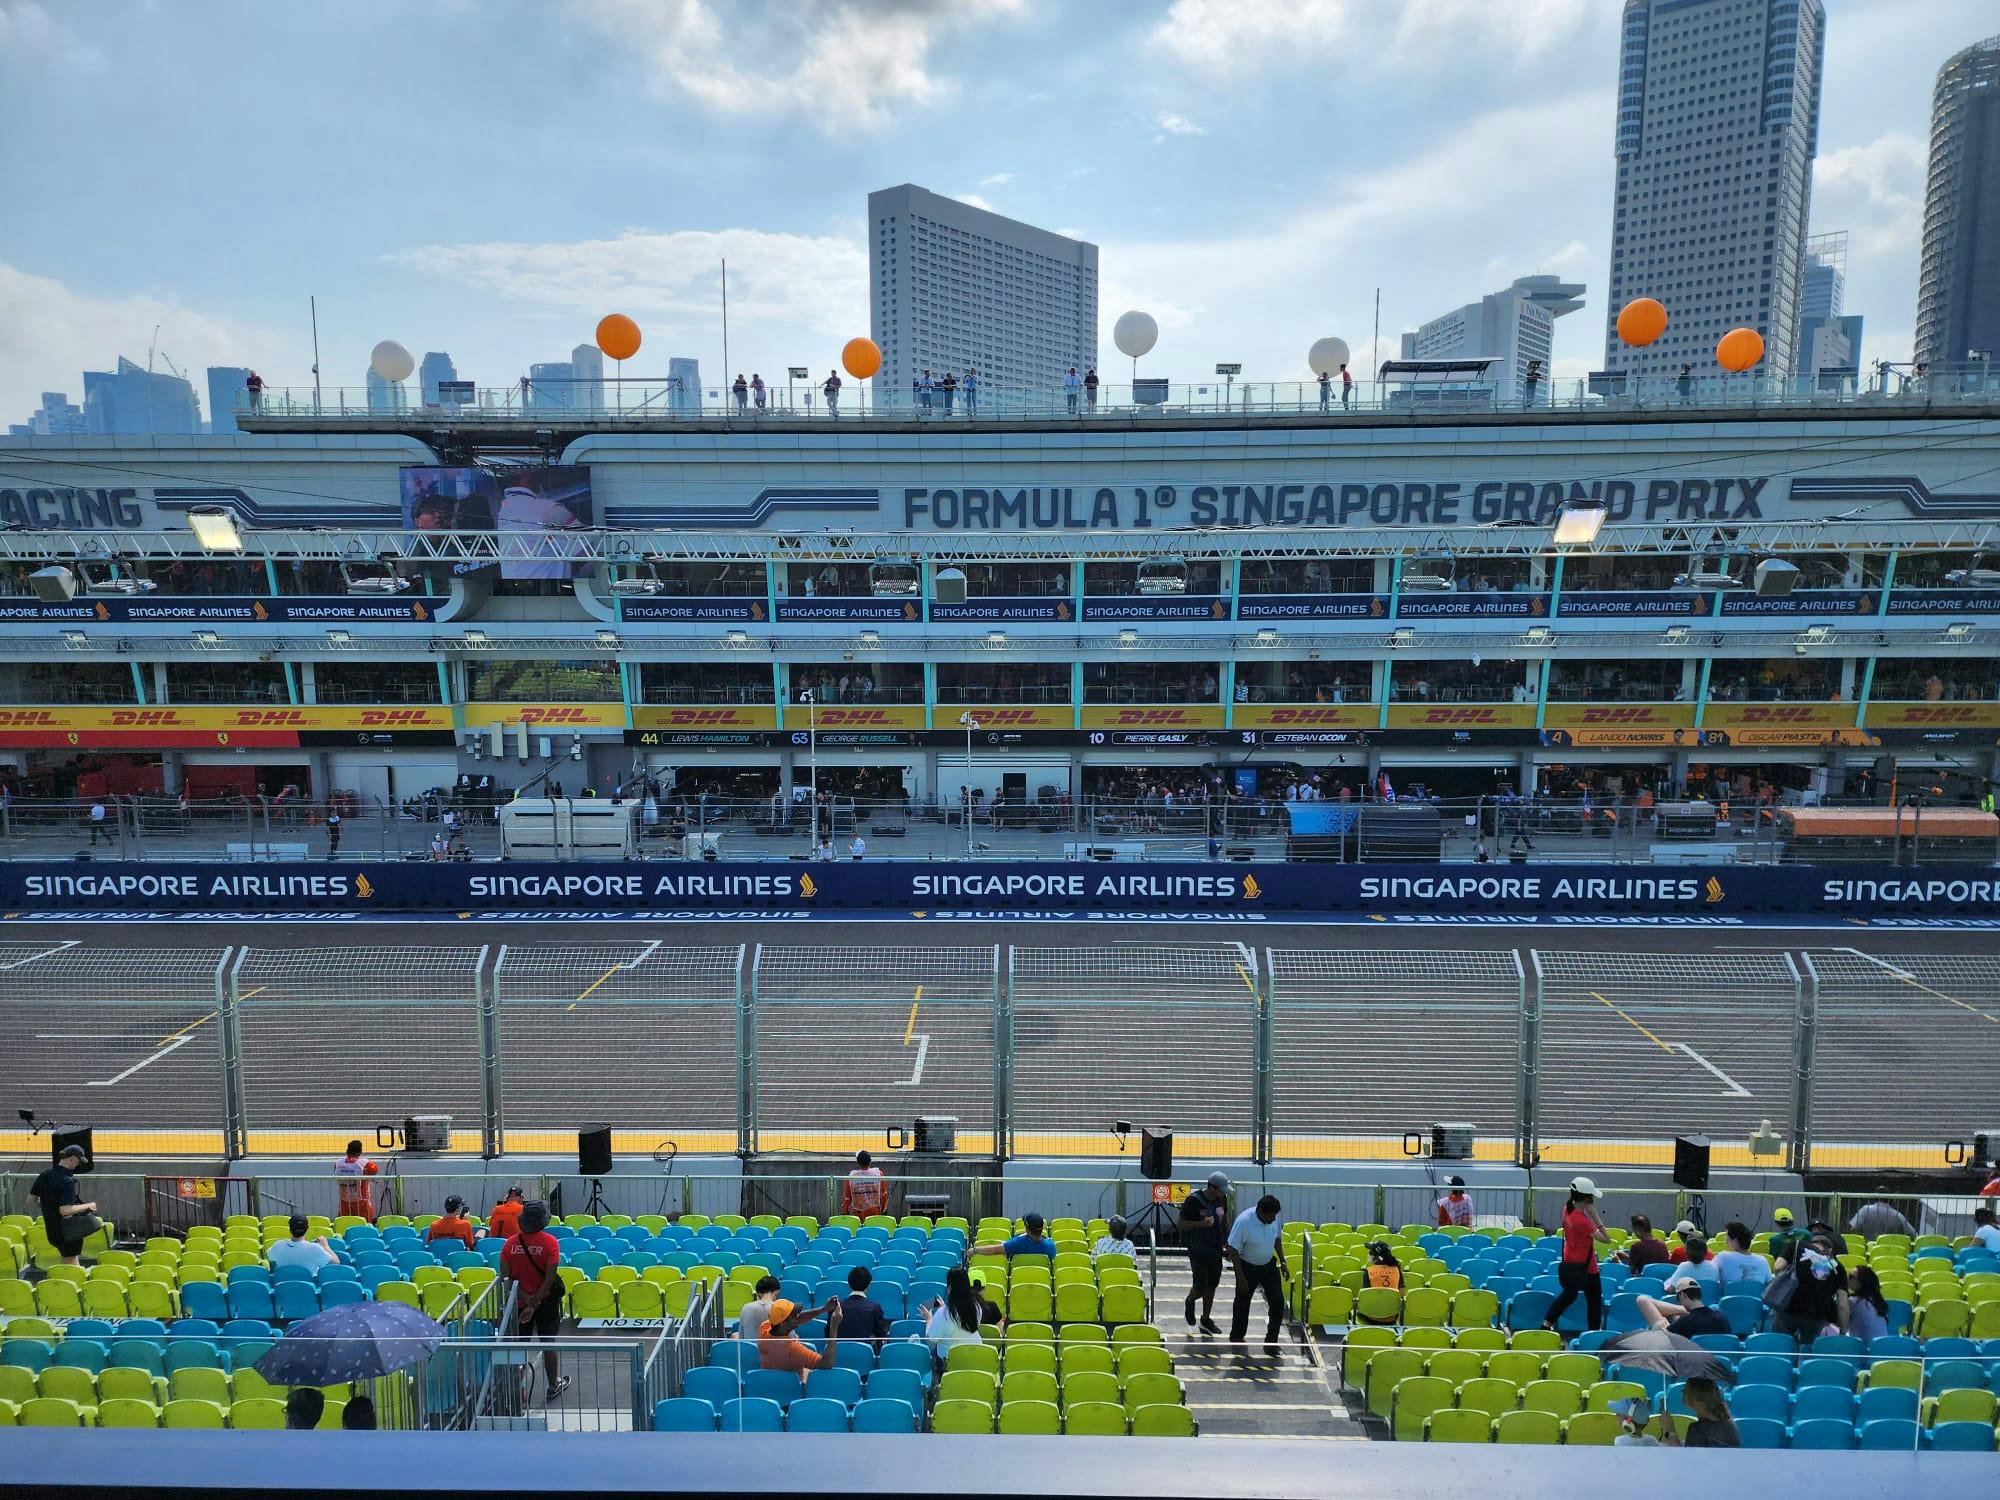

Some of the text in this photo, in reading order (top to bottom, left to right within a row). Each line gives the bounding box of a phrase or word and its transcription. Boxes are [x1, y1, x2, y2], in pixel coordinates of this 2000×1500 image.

[0, 489, 142, 527] ACING
[905, 488, 1119, 529] FORMULA
[1191, 483, 1461, 526] SINGAPORE
[1645, 478, 1769, 521] PRIX
[1241, 604, 1367, 615] SINGAPORE AIRLINES
[1401, 603, 1528, 614] SINGAPORE AIRLINES
[1560, 601, 1691, 613] SINGAPORE AIRLINES
[1724, 599, 1856, 611] SINGAPORE AIRLINES
[1889, 598, 1963, 609] SINGAPORE
[0, 608, 94, 618] APORE AIRLINES
[128, 607, 252, 617] SINGAPORE AIRLINES
[287, 607, 411, 617] SINGAPORE AIRLINES
[625, 607, 749, 618] SINGAPORE AIRLINES
[780, 607, 902, 618] SINGAPORE AIRLINES
[933, 607, 1054, 618] SINGAPORE AIRLINES
[1086, 606, 1209, 616] SINGAPORE AIRLINES
[111, 711, 183, 726] DHL
[237, 711, 309, 726] DHL
[361, 710, 432, 725] DHL
[520, 708, 590, 723] DHL
[669, 710, 740, 725] DHL
[820, 710, 892, 725] DHL
[969, 710, 1039, 725] DHL
[1118, 709, 1188, 724] DHL
[1270, 709, 1343, 724] DHL
[1425, 709, 1498, 724] DHL
[1581, 708, 1657, 723] DHL
[1740, 708, 1816, 722] DHL
[1903, 707, 1978, 722] DHL
[640, 733, 750, 745] 44 LEWIS HAMILTON
[791, 732, 898, 744] 63 GEORGE RUSSELL
[1088, 732, 1188, 745] 10 PIERRE GASLY
[1242, 732, 1347, 744] 31 ESTEBAN OCON
[1552, 732, 1666, 744] 4 LANDO NORRIS
[1708, 732, 1823, 744] 81 OSCAR PIASTRI
[26, 876, 347, 896] SINGAPORE AIRLINES
[470, 876, 791, 896] SINGAPORE AIRLINES
[913, 876, 1234, 897] SINGAPORE AIRLINES
[1361, 878, 1697, 900] SINGAPORE AIRLINES
[477, 911, 811, 919] SINGAPORE AIRLINES
[934, 911, 1267, 920] SINGAPORE AIRLINES
[1394, 914, 1744, 924] SINGAPORE AIRLINES
[1380, 1275, 1391, 1287] 3
[601, 1318, 628, 1327] NO
